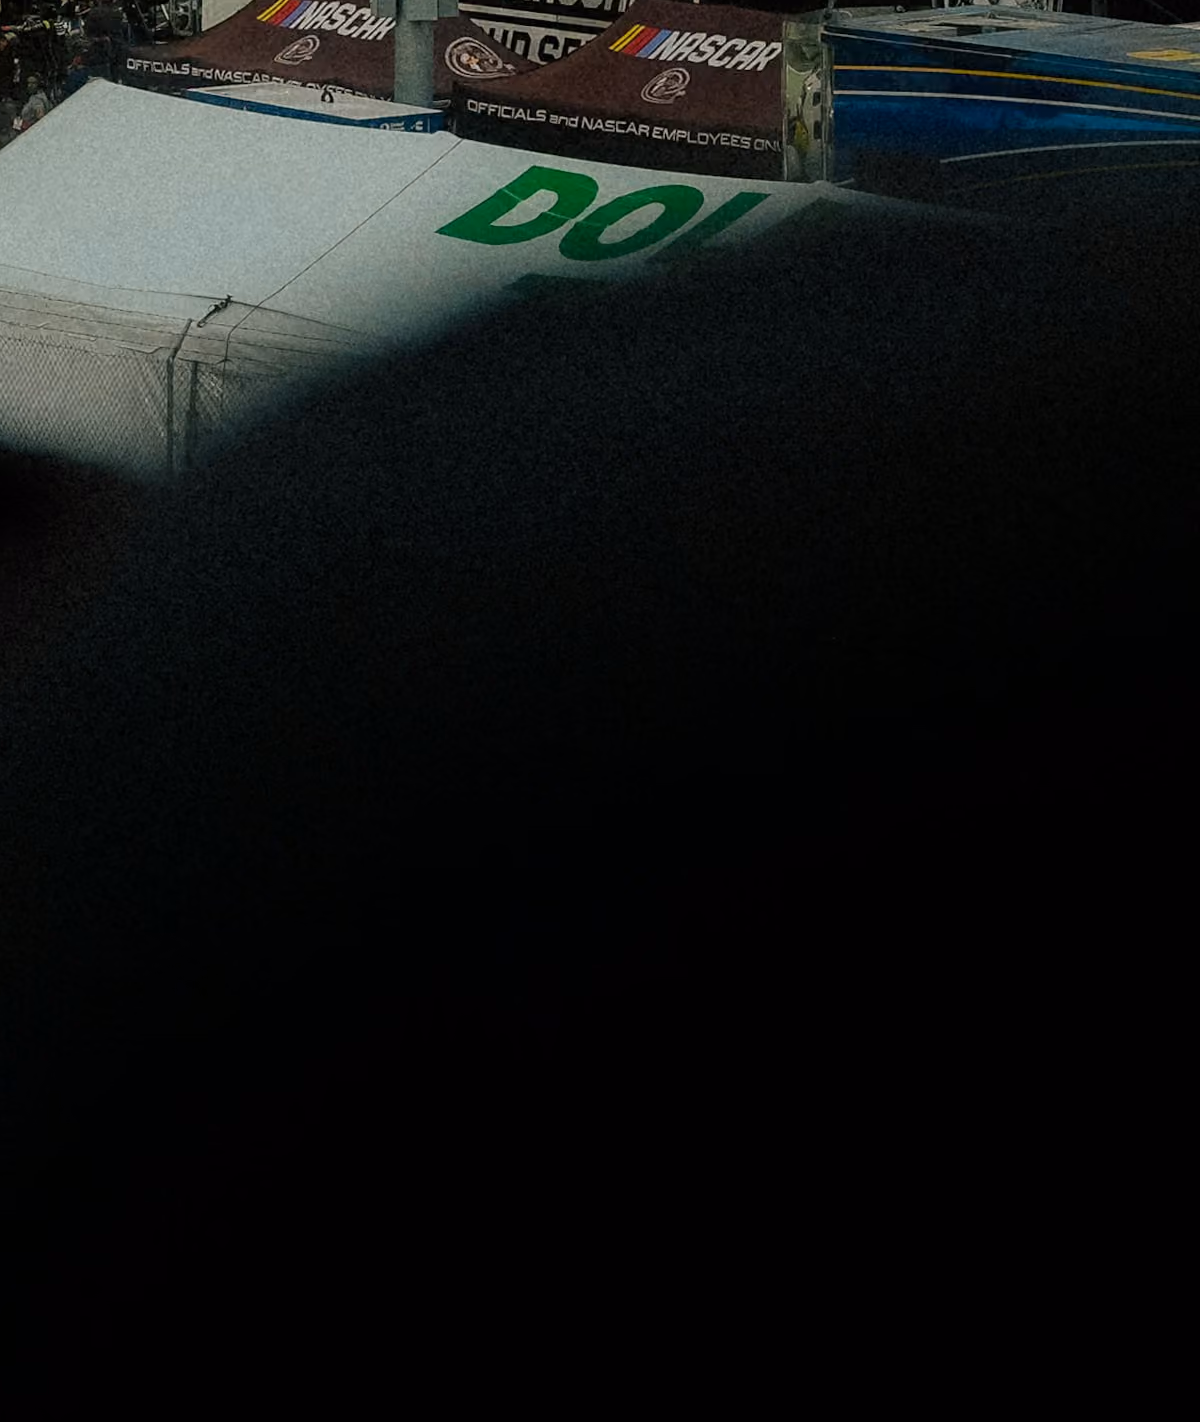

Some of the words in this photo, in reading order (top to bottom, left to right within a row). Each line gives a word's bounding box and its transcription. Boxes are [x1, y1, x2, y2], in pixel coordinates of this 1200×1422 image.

[126, 58, 190, 76] OFFICIALS
[191, 67, 213, 80] and
[648, 30, 783, 71] NASCAR
[467, 99, 547, 122] OFFICIALS
[549, 113, 578, 128] and
[581, 117, 649, 137] NASCAR
[651, 127, 751, 149] EMPLOYEES
